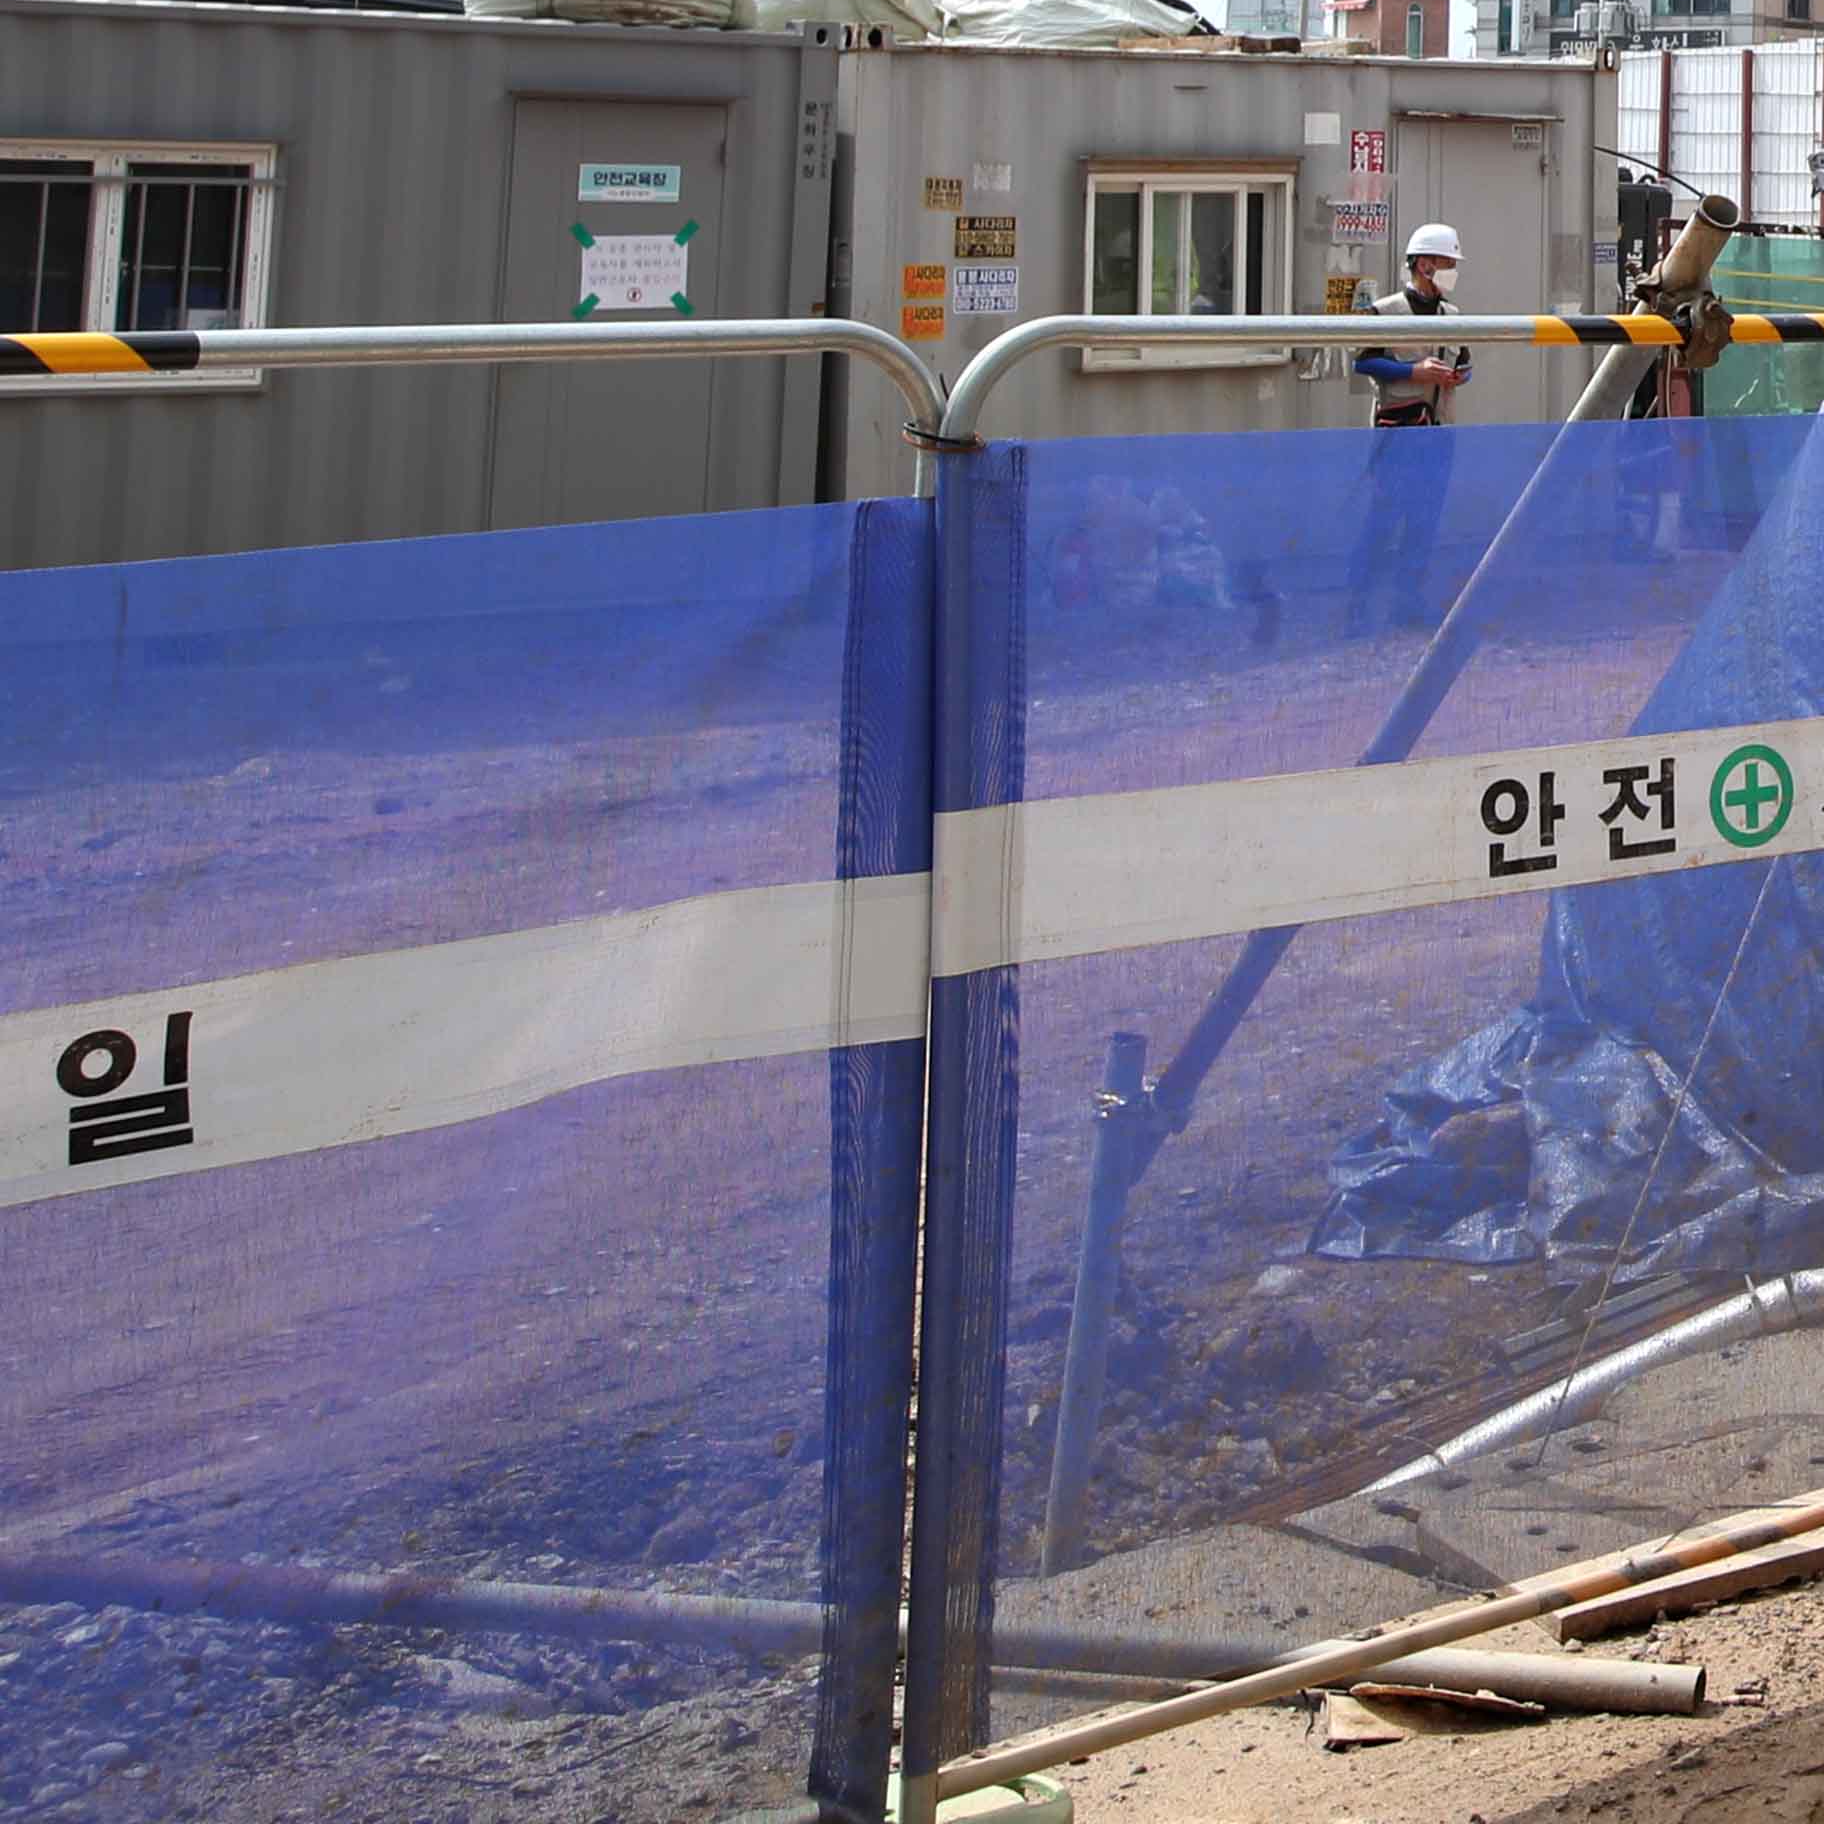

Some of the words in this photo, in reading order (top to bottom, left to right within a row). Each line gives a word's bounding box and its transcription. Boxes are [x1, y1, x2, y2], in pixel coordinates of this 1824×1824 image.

[593, 170, 667, 187] 안전교육장
[1479, 755, 1680, 879] 안전
[54, 1010, 194, 1167] 일
